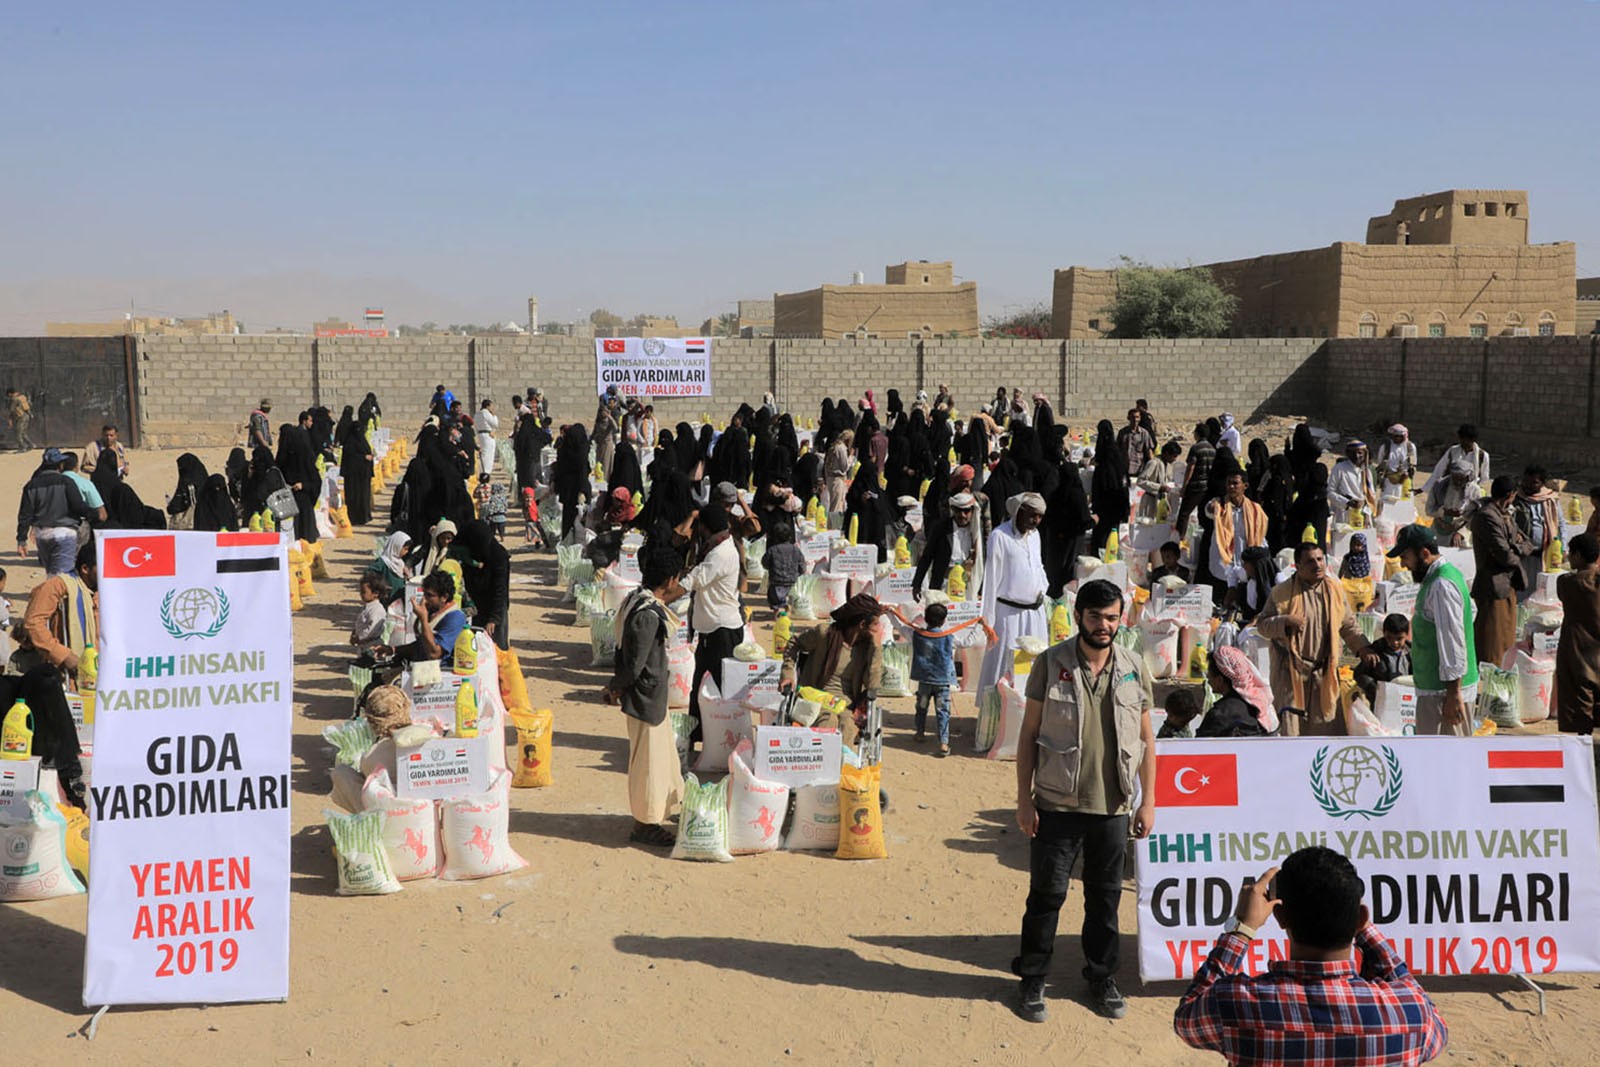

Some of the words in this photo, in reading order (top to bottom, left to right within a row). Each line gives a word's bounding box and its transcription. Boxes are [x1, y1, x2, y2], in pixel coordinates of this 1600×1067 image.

[602, 369, 630, 382] GIDA
[633, 369, 705, 382] YARDIMLARI
[645, 384, 678, 394] ARALIK
[680, 384, 702, 394] 2019
[98, 686, 201, 711] YARDIM
[207, 681, 280, 706] VAKFI
[146, 732, 242, 776] GIDA
[410, 770, 426, 779] GIDA
[427, 767, 469, 777] YARDIMLARI
[91, 774, 288, 821] YARDIMLARI
[1336, 830, 1468, 860] YARDIM
[1475, 829, 1568, 859] VAKFI
[129, 856, 250, 898] YEMEN
[132, 896, 255, 940] ARALIK
[1151, 876, 1258, 927] GID
[1371, 872, 1569, 925] DIMLARI
[155, 937, 239, 977] 2019
[1166, 939, 1291, 979] YEEN
[1470, 936, 1558, 975] 2019
